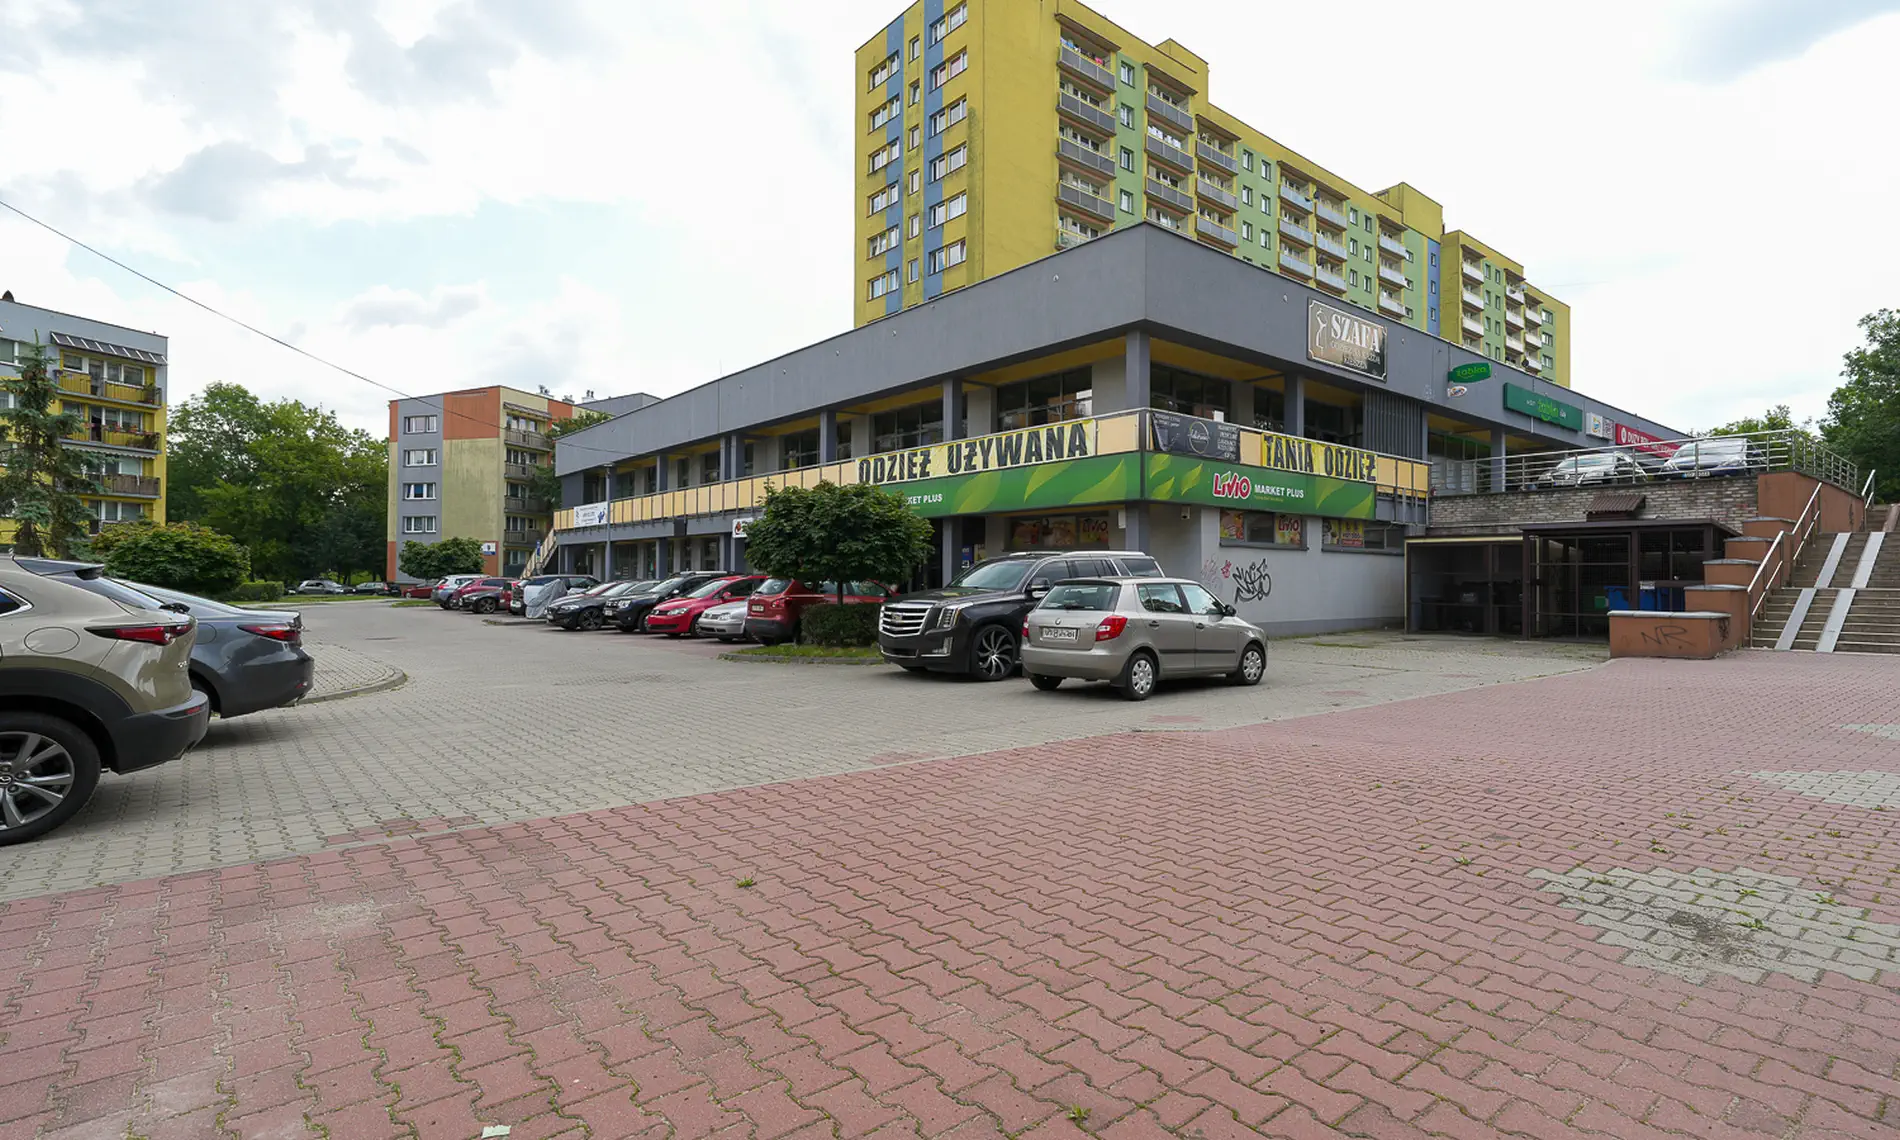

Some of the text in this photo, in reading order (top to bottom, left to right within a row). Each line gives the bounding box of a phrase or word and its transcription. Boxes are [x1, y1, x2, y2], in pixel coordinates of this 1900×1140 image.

[858, 422, 1088, 484] ODZIEŻ UŻYWANA
[1264, 435, 1315, 473] TANIA
[1324, 446, 1377, 482] ODZIEŻ
[923, 493, 943, 503] PLUS
[1255, 484, 1285, 496] MARKET
[1286, 487, 1304, 498] PLUS
